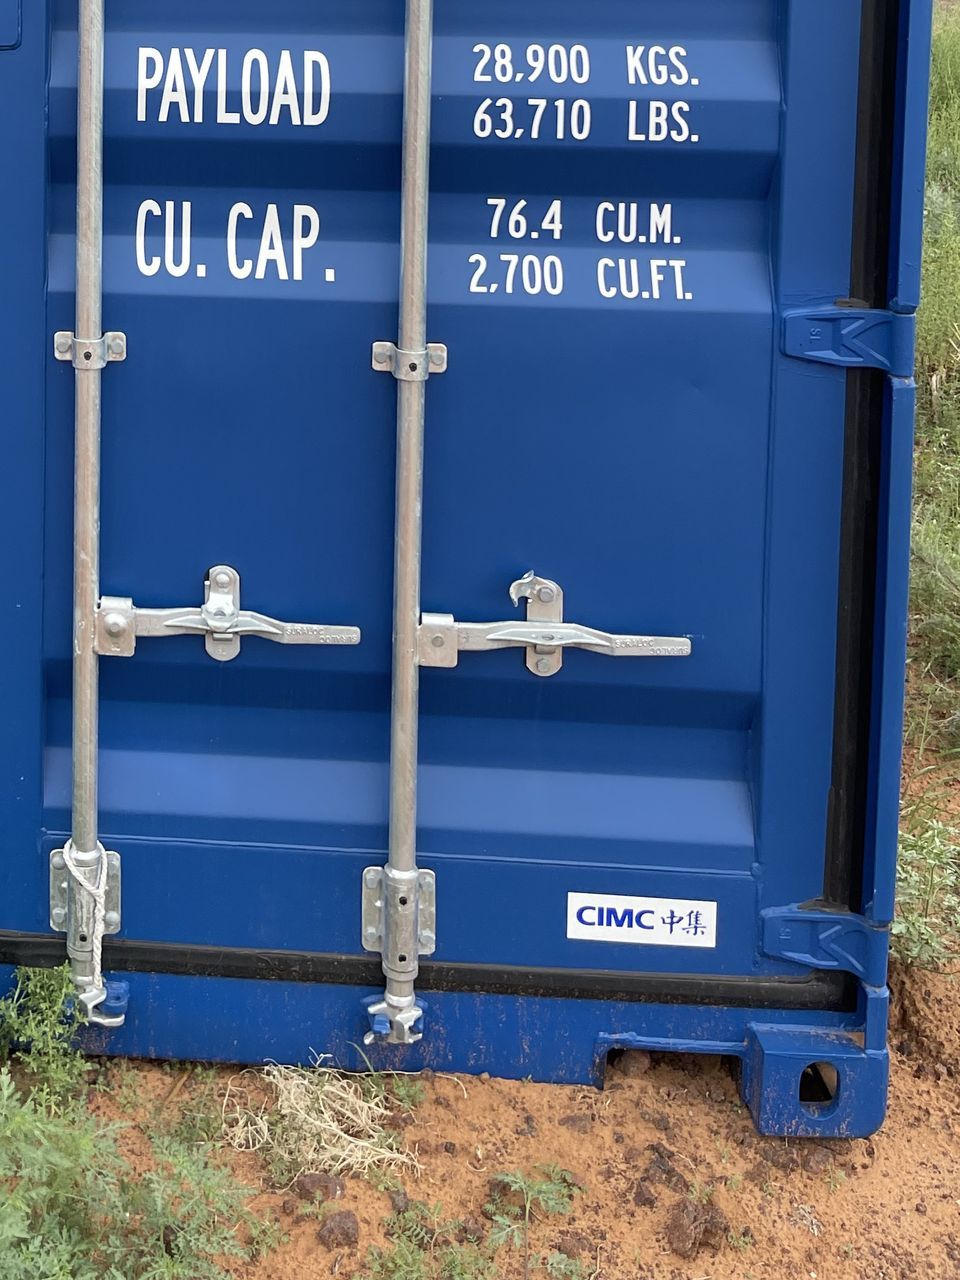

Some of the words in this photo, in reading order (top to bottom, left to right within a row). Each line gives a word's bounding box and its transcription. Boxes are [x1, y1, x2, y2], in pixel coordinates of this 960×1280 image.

[137, 46, 331, 126] PAYLOAD
[472, 43, 590, 84] 28,900
[626, 45, 700, 86] KGS.
[473, 97, 591, 140] 63,710
[628, 100, 699, 142] LBS.
[135, 199, 207, 278] CU.
[226, 201, 335, 282] CAP.
[487, 198, 563, 240] 76.4
[596, 201, 681, 244] CU.M.
[468, 253, 564, 296] 2,700
[597, 257, 693, 300] CU.FT.
[576, 905, 655, 930] CIMC
[660, 908, 707, 936] 中集
